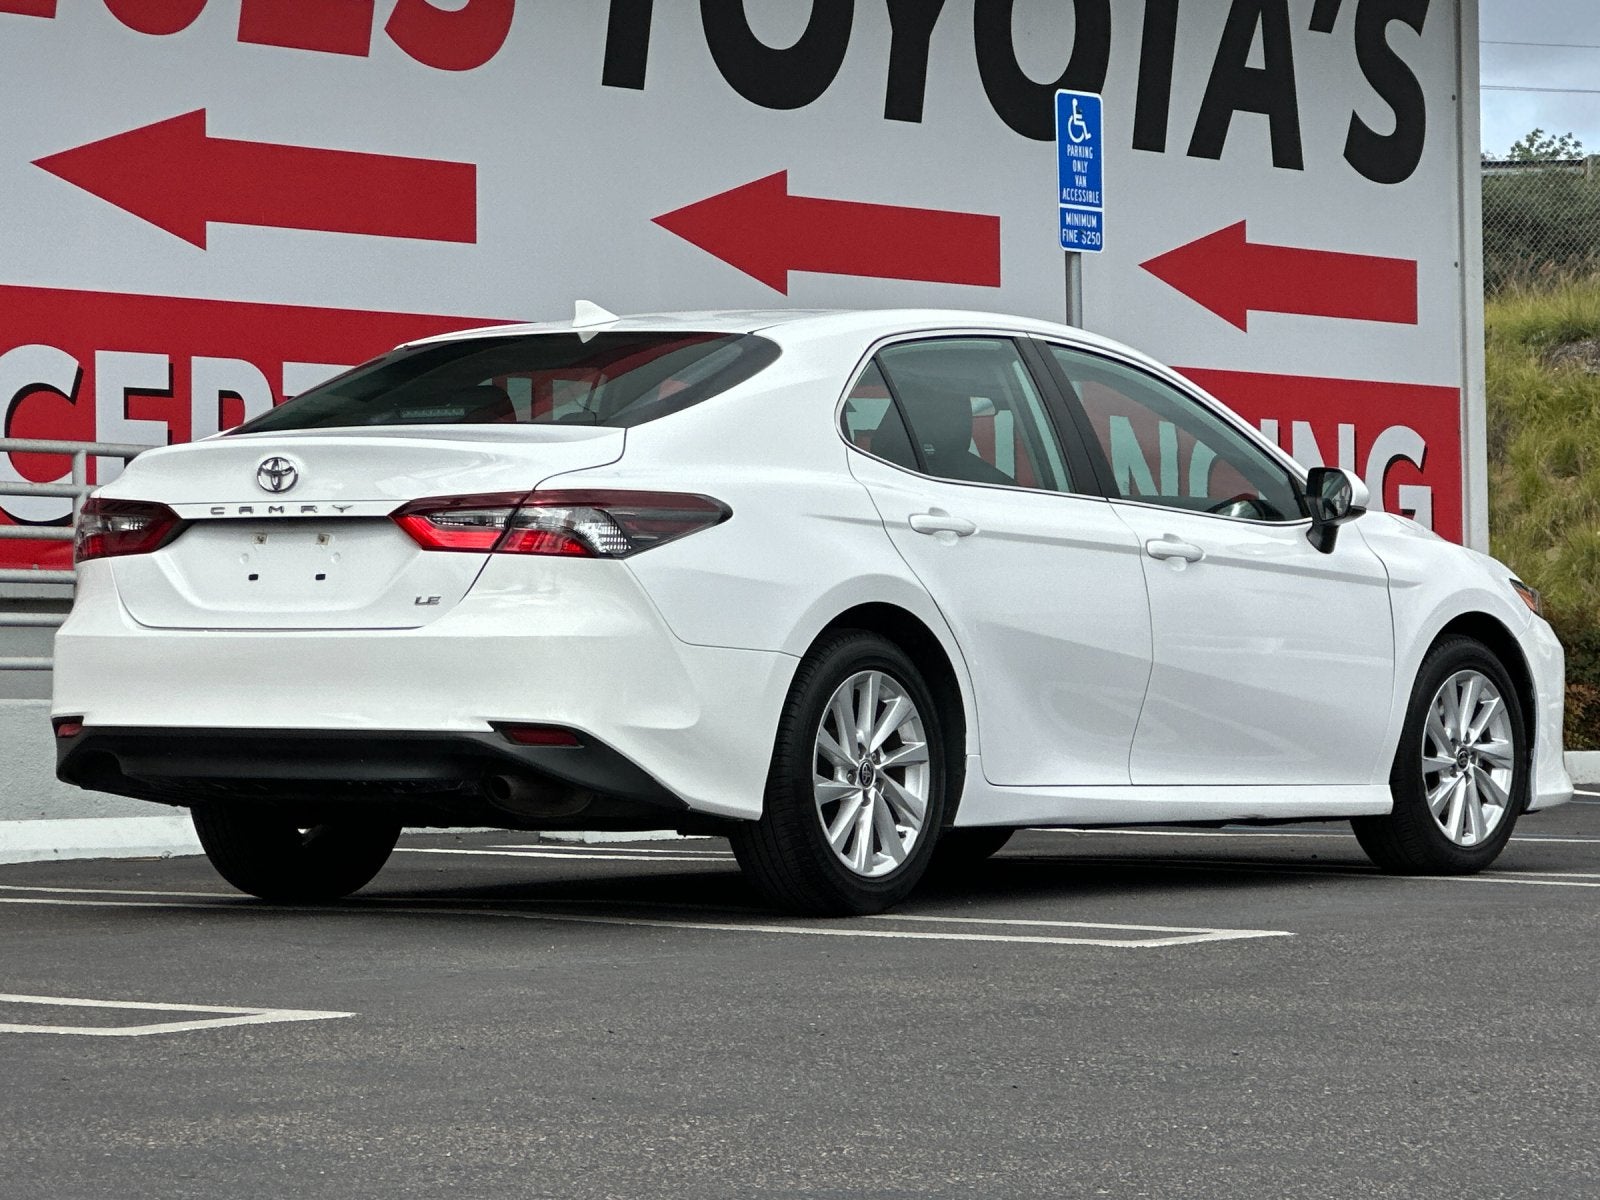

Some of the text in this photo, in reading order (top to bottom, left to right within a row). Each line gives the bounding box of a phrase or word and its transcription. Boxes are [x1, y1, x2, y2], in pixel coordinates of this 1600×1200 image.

[1066, 144, 1094, 159] PARKING
[1072, 160, 1089, 173] ONLY
[1074, 175, 1087, 187] VAN
[1062, 189, 1100, 204] ACCESSIBLE
[1065, 212, 1097, 228] MINIMUM
[1062, 228, 1101, 245] FINE $250
[210, 504, 353, 515] CAMRY
[414, 595, 441, 606] LE
